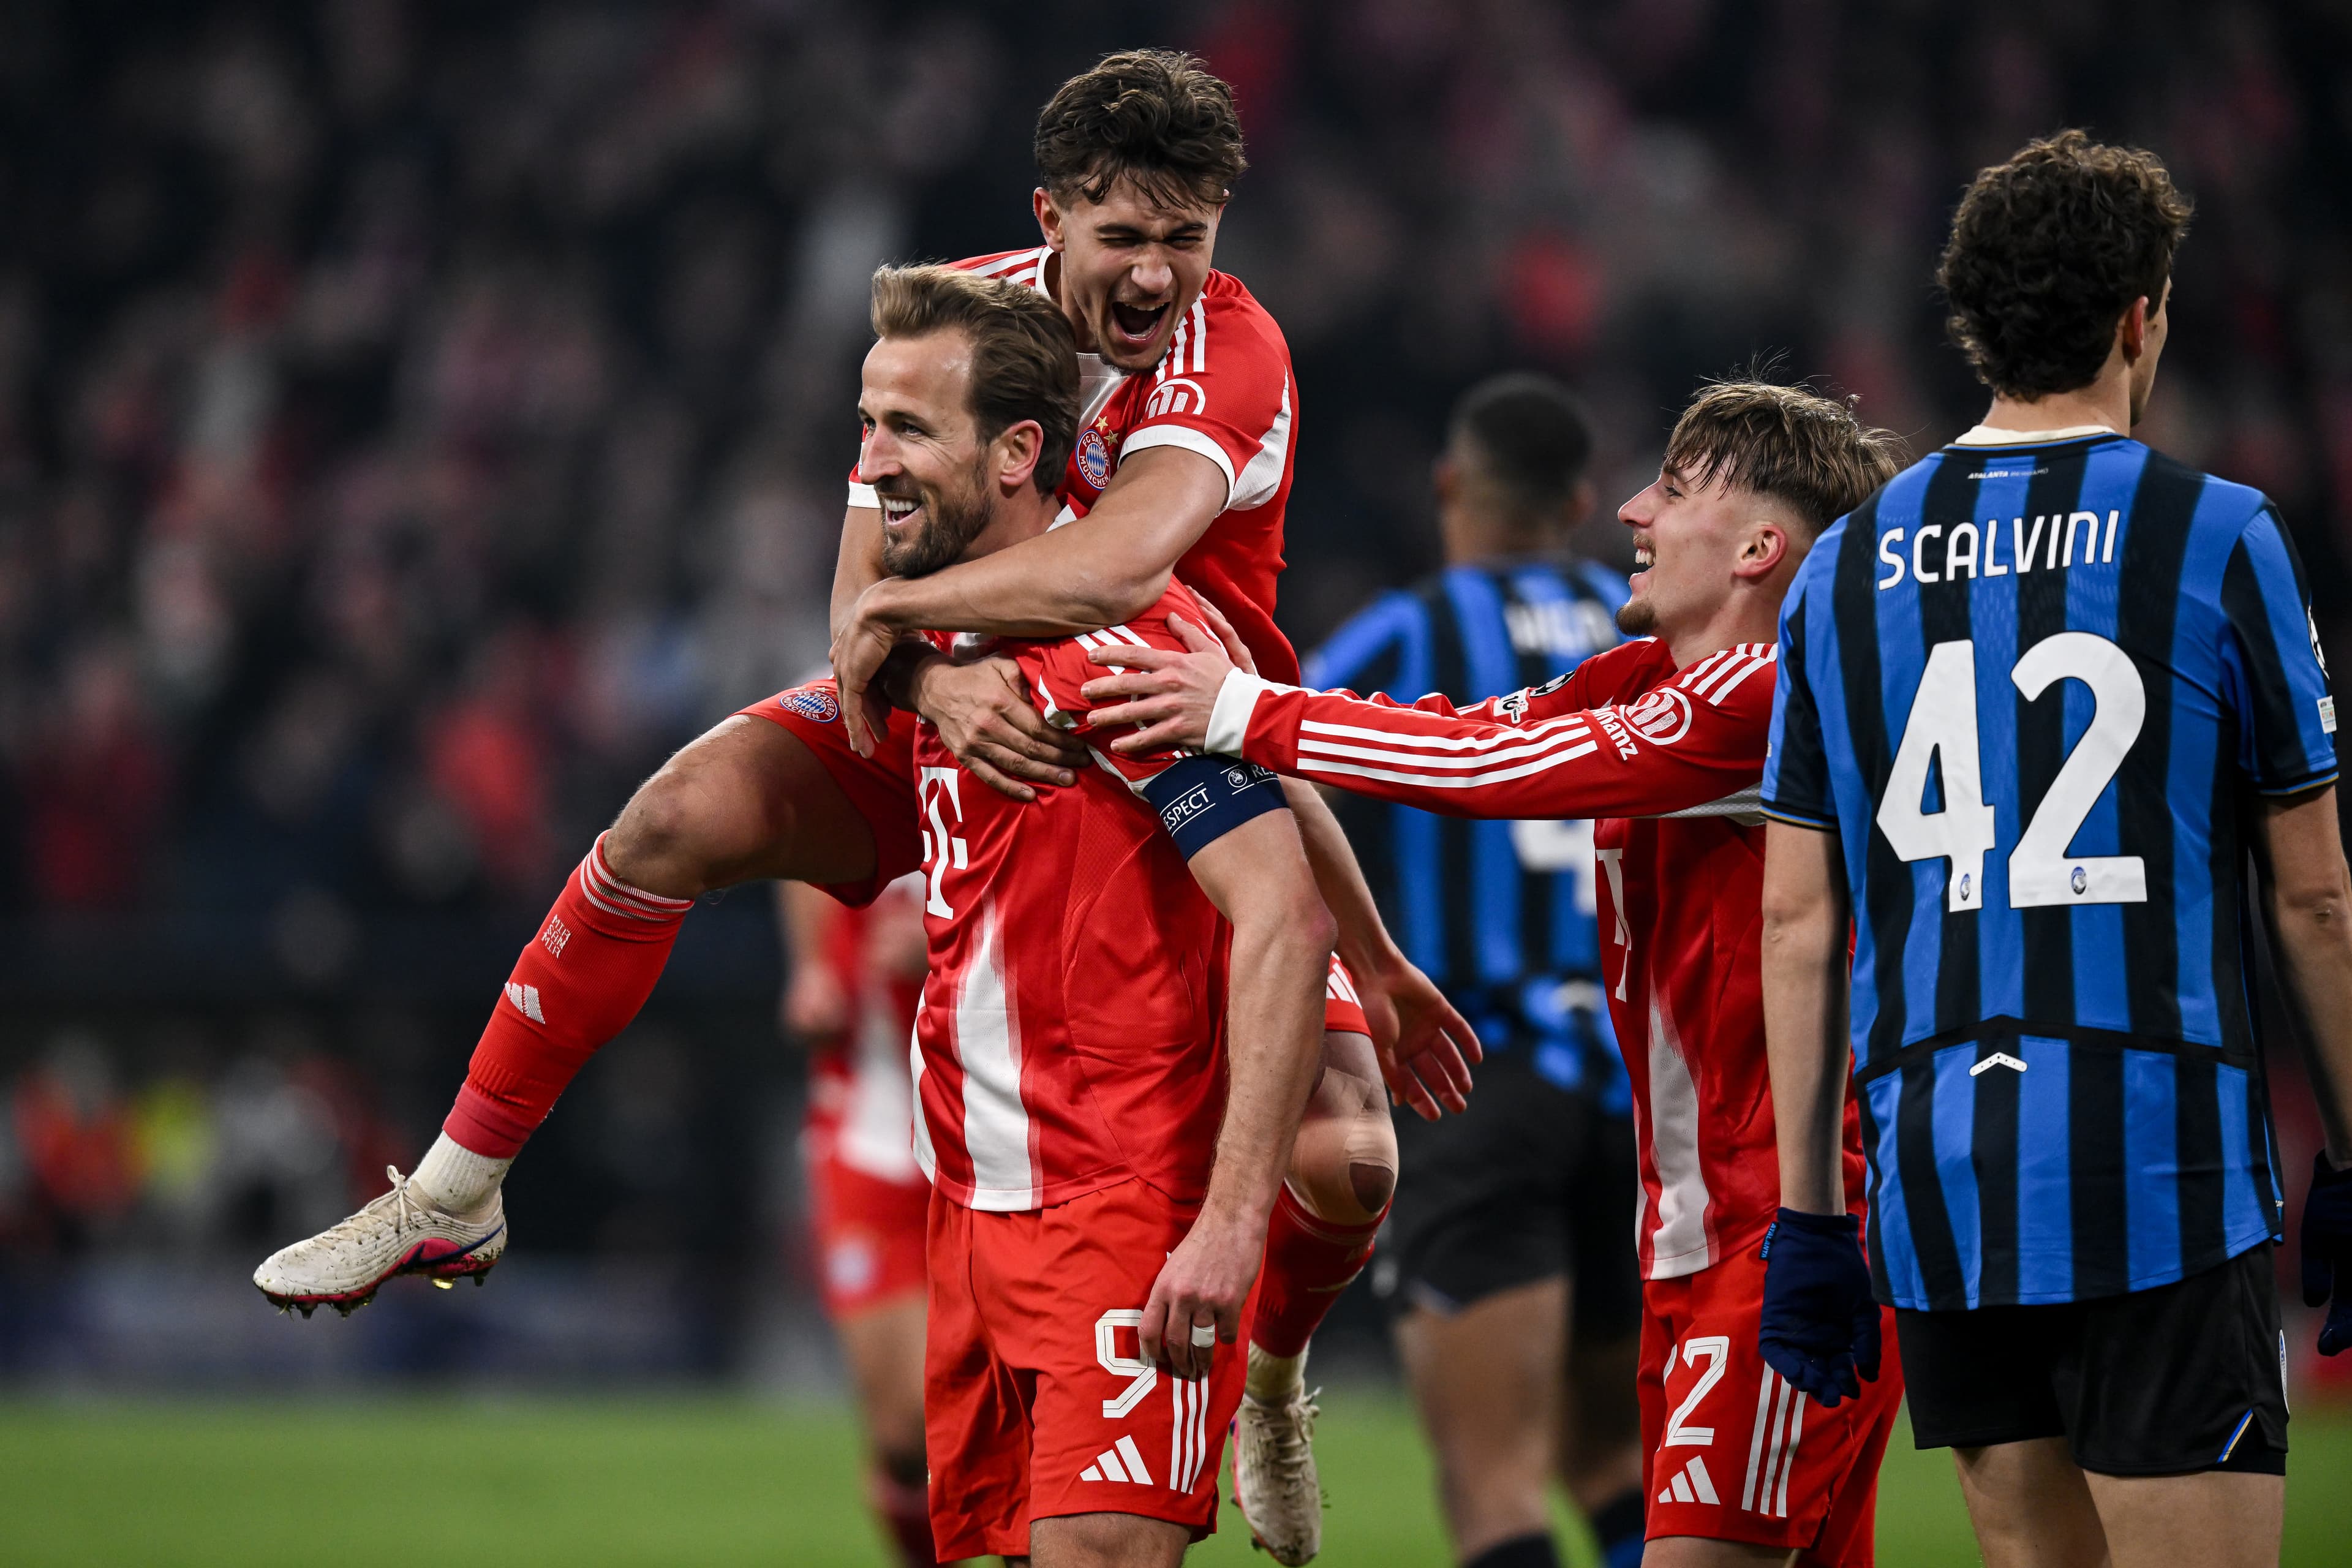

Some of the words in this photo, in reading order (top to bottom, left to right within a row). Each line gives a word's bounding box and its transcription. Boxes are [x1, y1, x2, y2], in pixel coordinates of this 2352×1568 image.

[1082, 435, 1091, 447] FC
[1878, 509, 2120, 591] SCALVINI
[1163, 787, 1210, 832] ESPECT
[1875, 631, 2147, 913] 42
[1095, 1308, 1157, 1419] 9
[1656, 1335, 1730, 1453] 2
